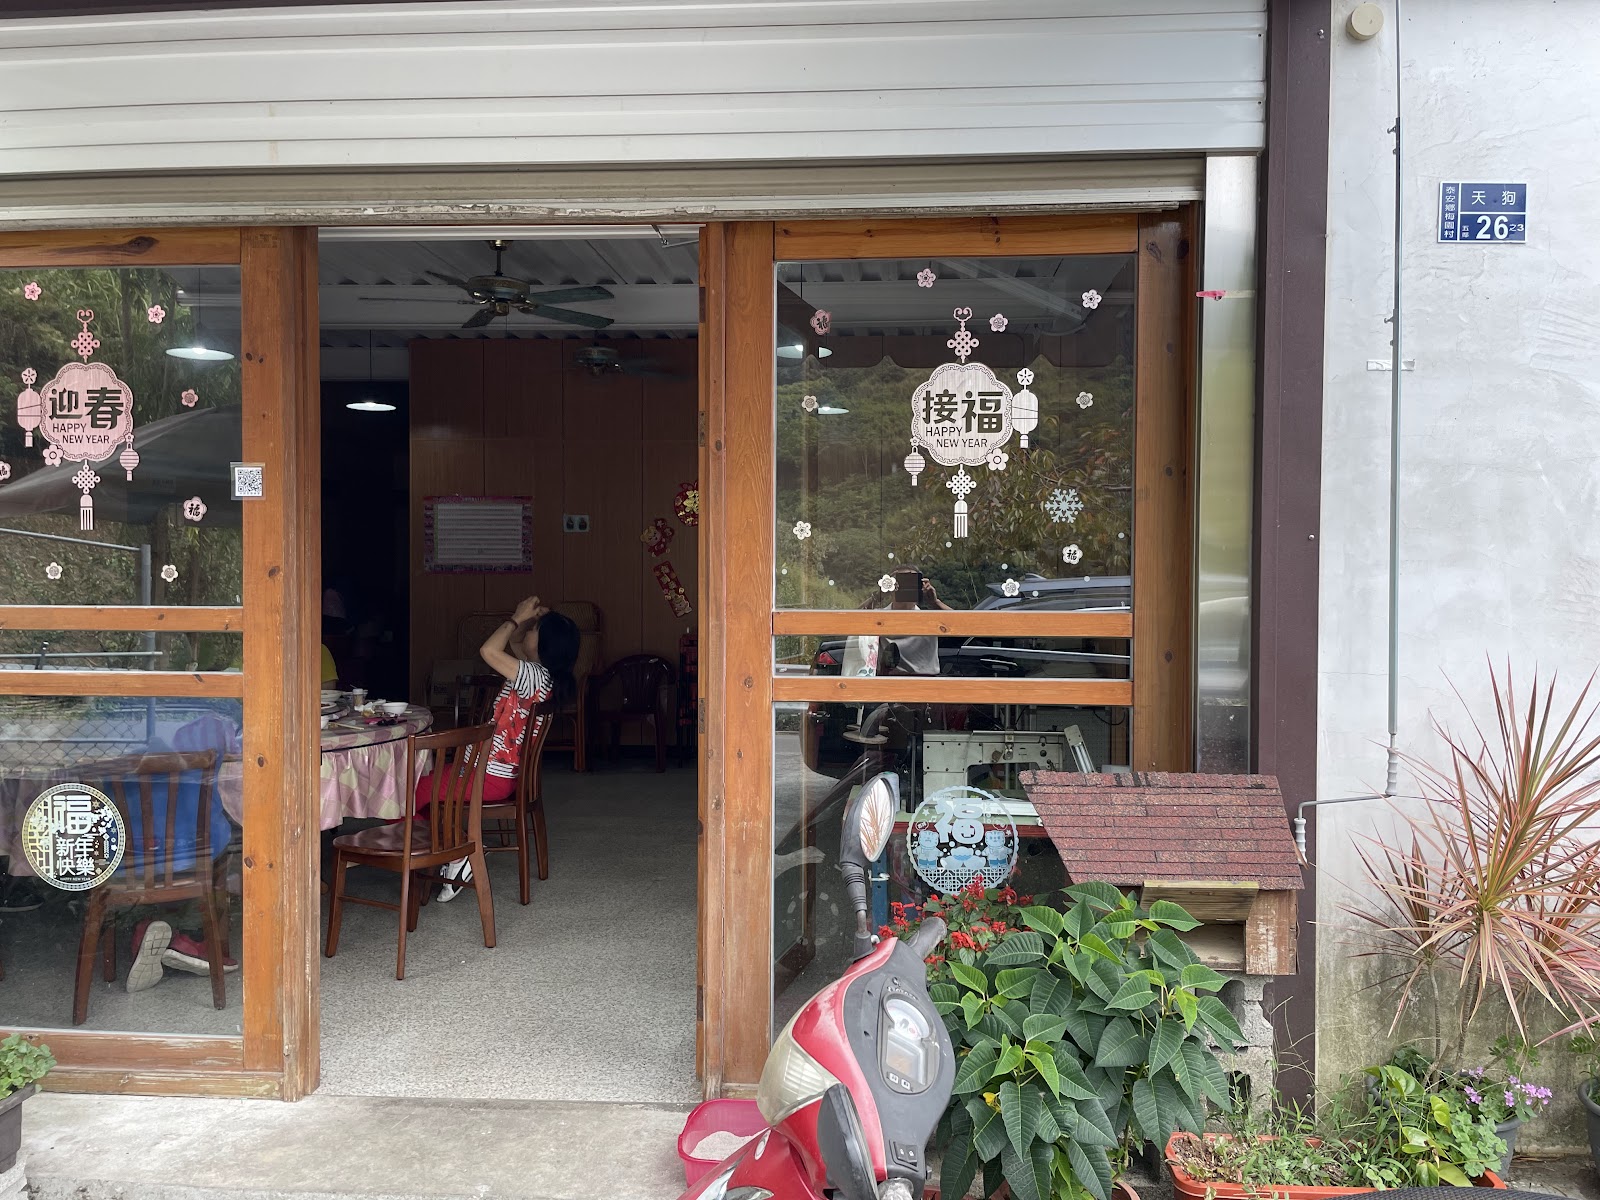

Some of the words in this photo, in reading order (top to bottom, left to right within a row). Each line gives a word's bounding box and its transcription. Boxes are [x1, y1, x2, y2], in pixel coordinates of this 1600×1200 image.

[1471, 190, 1516, 206] 天狗
[1443, 186, 1456, 238] 泰安鄉梅園村
[48, 387, 124, 430] 迎春
[922, 389, 1003, 434] 接福
[52, 423, 87, 433] HAPPY
[925, 426, 963, 437] HAPPY
[62, 435, 84, 444] NEW
[86, 435, 110, 444] YEAR
[936, 438, 959, 448] NEW
[962, 438, 988, 448] YEAR
[188, 503, 201, 517] 福
[1066, 549, 1078, 561] 福
[52, 795, 92, 835] 福
[56, 837, 95, 859] 新年
[56, 857, 96, 876] 快樂
